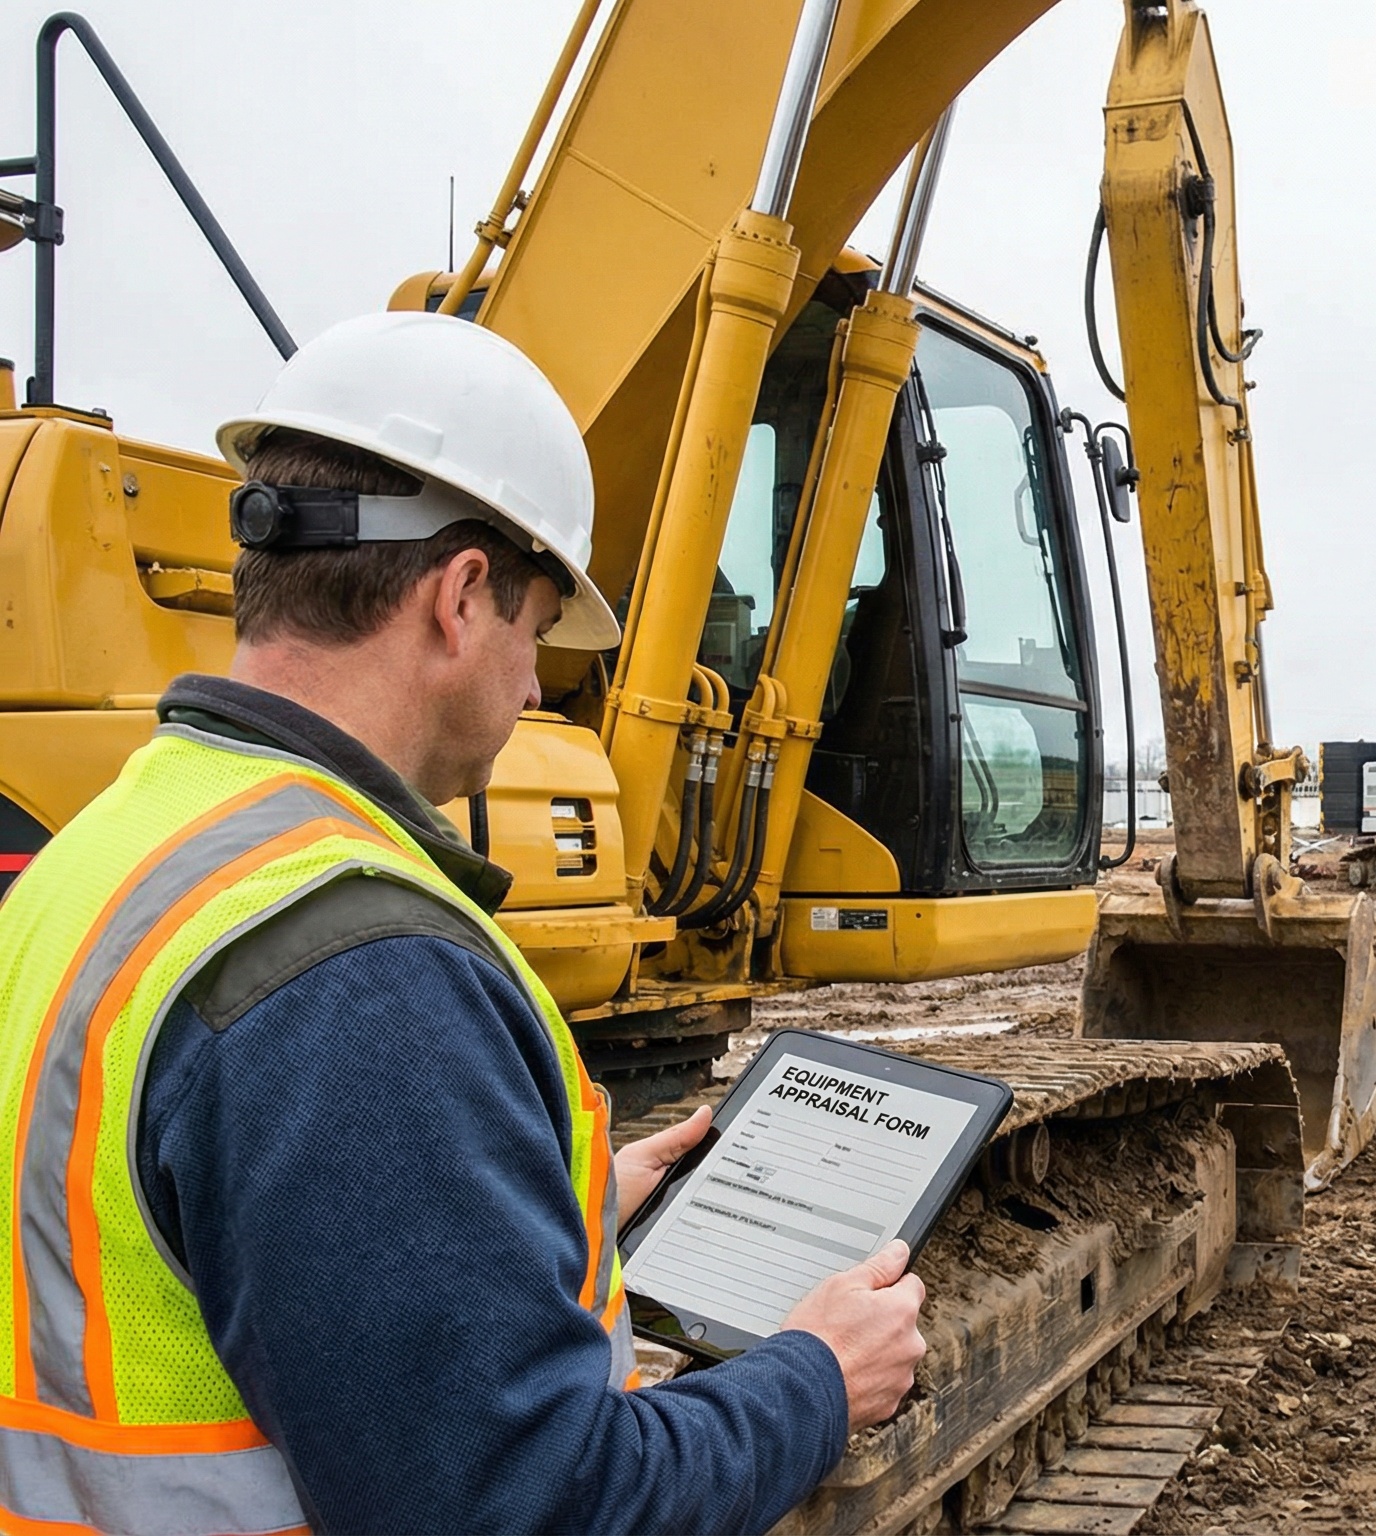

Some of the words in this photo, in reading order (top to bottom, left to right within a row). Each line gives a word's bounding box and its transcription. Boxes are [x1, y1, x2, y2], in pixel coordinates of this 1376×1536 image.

[781, 1066, 889, 1106] EQUIPMENT
[768, 1083, 869, 1123] APPRAISAL
[873, 1112, 931, 1140] FORM
